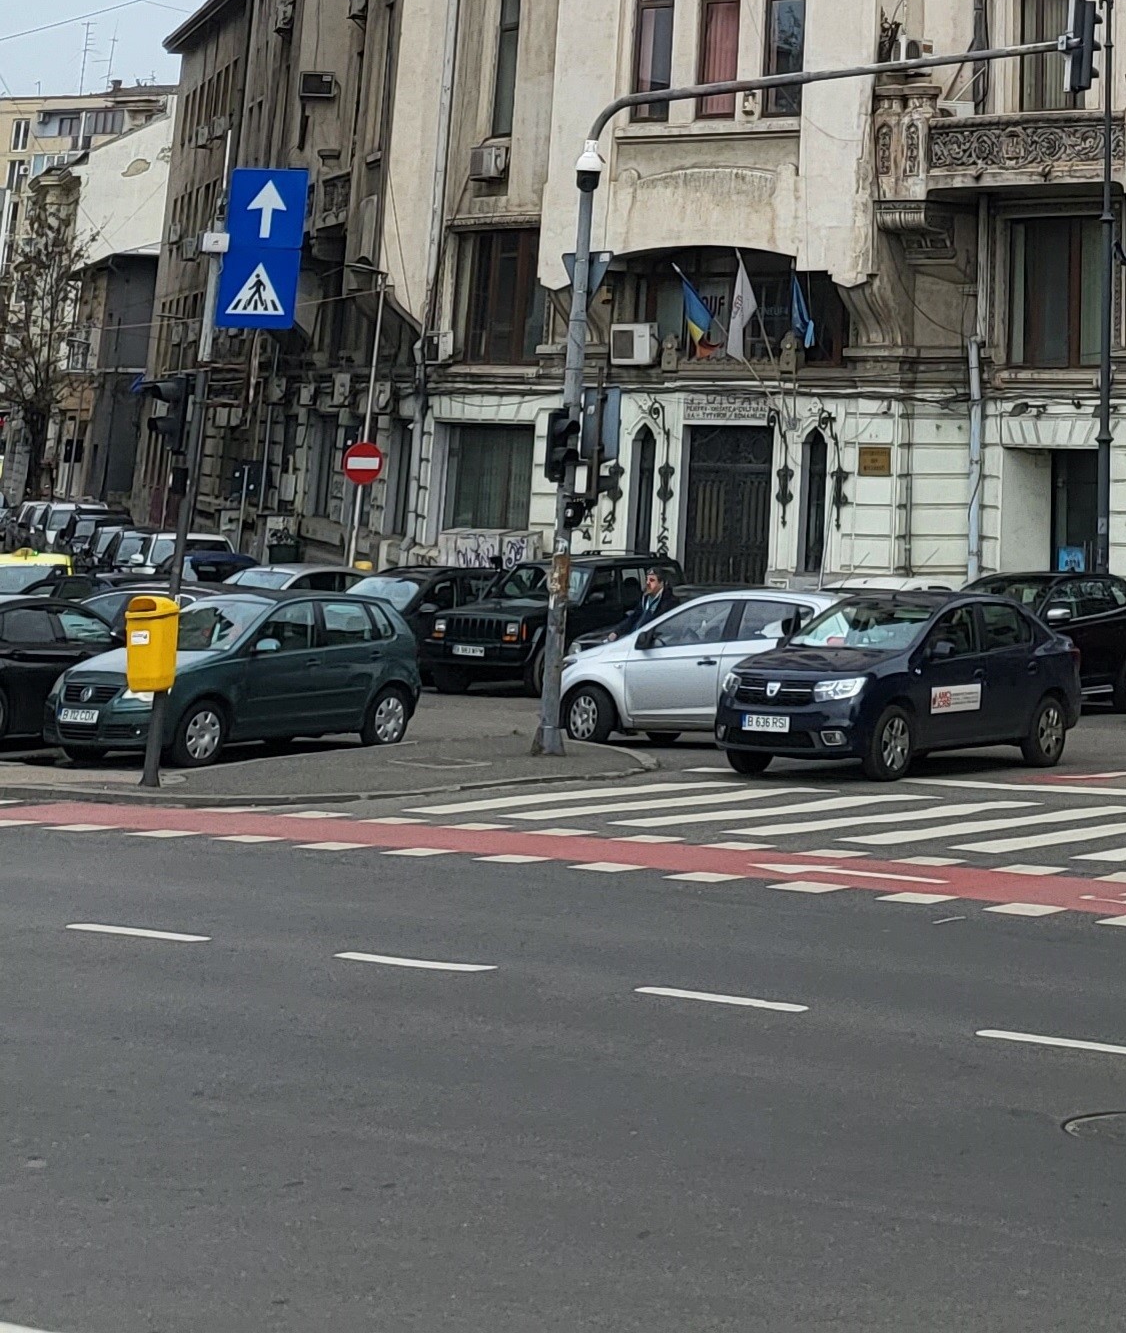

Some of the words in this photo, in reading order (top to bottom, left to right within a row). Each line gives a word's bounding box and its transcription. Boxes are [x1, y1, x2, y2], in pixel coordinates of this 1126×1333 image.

[62, 709, 69, 720] B
[747, 716, 755, 727] B
[755, 716, 771, 728] 636
[771, 717, 787, 729] RSI
